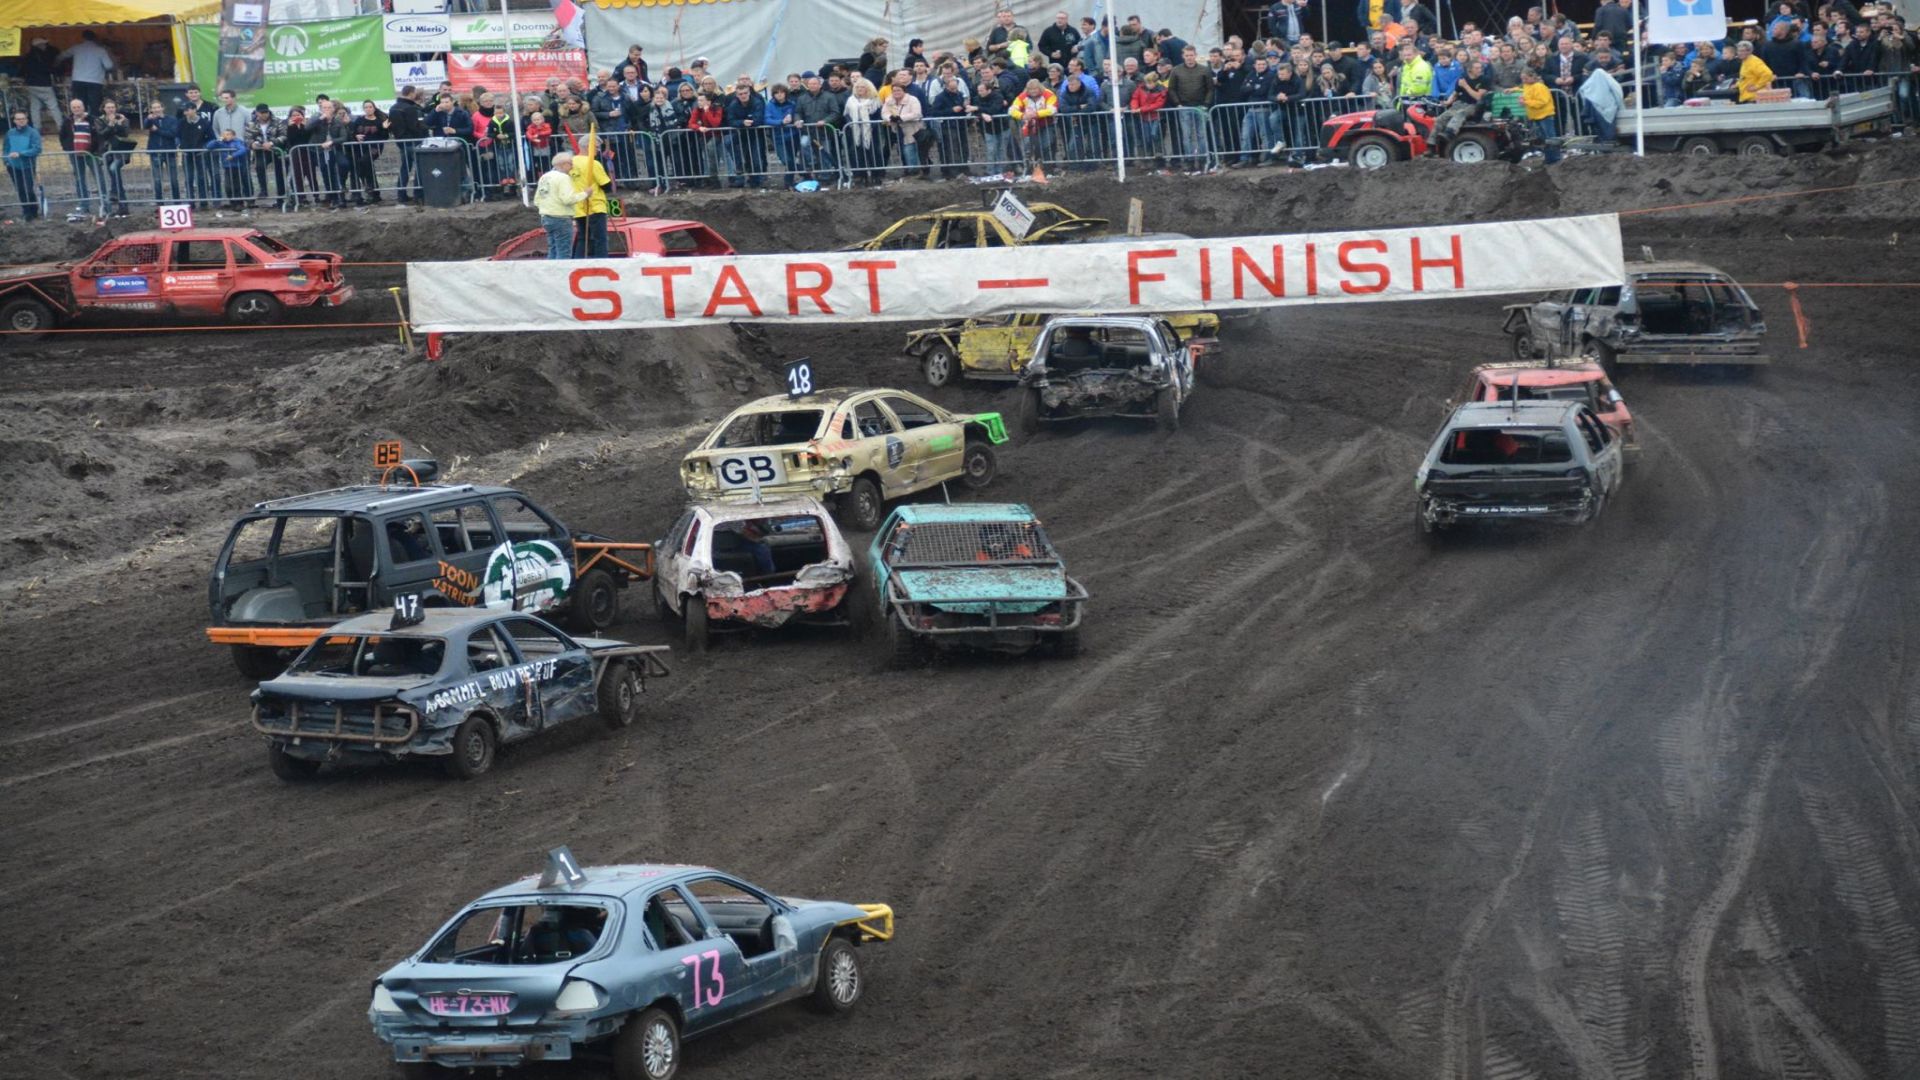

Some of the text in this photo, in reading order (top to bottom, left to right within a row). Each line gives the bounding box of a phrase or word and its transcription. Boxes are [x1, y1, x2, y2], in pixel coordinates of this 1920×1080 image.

[416, 25, 442, 33] Mieris
[263, 57, 341, 75] ERTENS
[164, 208, 188, 226] 30
[569, 260, 897, 321] START
[1127, 234, 1465, 305] FINISH
[788, 364, 811, 395] 18
[377, 443, 399, 465] 85
[721, 455, 776, 485] GB
[438, 560, 479, 590] TOON
[395, 594, 419, 618] 47
[559, 852, 581, 881] 1
[681, 949, 725, 1010] 73
